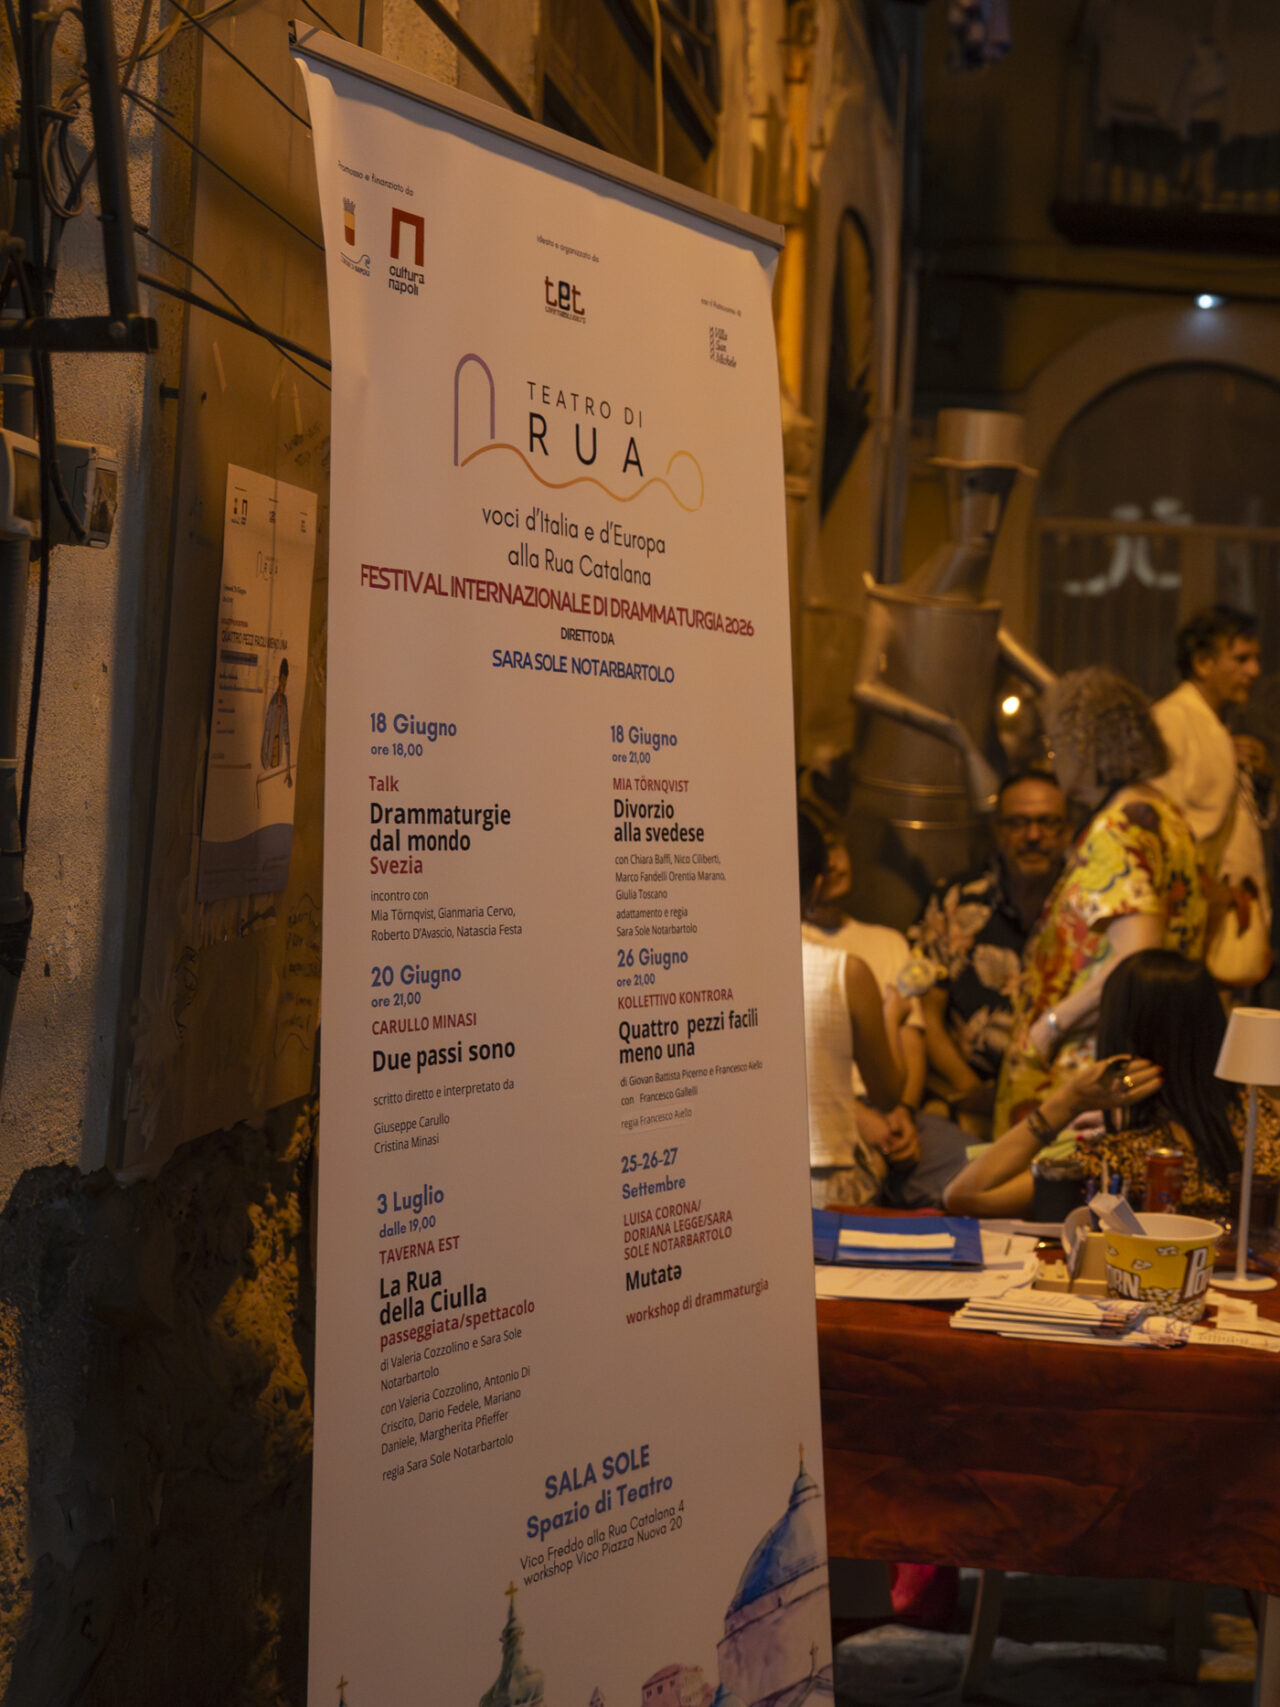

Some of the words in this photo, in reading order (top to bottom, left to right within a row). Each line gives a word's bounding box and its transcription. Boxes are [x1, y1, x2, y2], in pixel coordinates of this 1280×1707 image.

[388, 278, 418, 297] napoli
[389, 264, 425, 285] cultura
[544, 275, 586, 316] tet
[526, 380, 612, 420] TEATRO
[624, 406, 643, 428] DI
[529, 412, 644, 477] RUA
[482, 506, 519, 529] voci
[526, 505, 578, 539] d'Italia
[584, 524, 594, 542] e
[600, 520, 666, 559] d'Europa
[508, 542, 540, 569] alla
[545, 548, 574, 575] Rua
[580, 554, 652, 586] Catalana
[360, 563, 448, 597] FESTIVAL
[450, 575, 591, 616] INTERNAZIONALE
[594, 594, 608, 617] DI
[610, 597, 724, 632] DRAMMATURGIA
[726, 614, 755, 637] 2026
[560, 626, 600, 644] DIRETTO
[601, 630, 615, 646] DA
[492, 648, 533, 670] SARA
[534, 652, 568, 674] SOLE
[570, 656, 676, 684] NOTARBARTOLO
[370, 712, 387, 733] 18
[393, 713, 457, 742] Giugno
[610, 724, 624, 744] 18
[628, 725, 678, 751] Giugno
[370, 745, 390, 756] ore
[392, 743, 424, 758] 18,00
[612, 752, 627, 763] ore
[368, 775, 400, 792] Talk
[612, 777, 632, 791] MIA
[634, 775, 690, 794] TÖRNQVIST
[370, 802, 512, 832] Drammaturgie
[613, 799, 675, 820] Divorzio
[370, 828, 400, 851] dal
[408, 828, 471, 851] mondo
[614, 822, 642, 842] alla
[646, 822, 705, 842] svedese
[370, 855, 423, 875] Svezia
[616, 872, 639, 882] Marco
[370, 890, 410, 902] incontro
[412, 890, 429, 901] con
[638, 888, 668, 900] Toscano
[371, 910, 388, 922] Mia
[438, 906, 484, 919] Gianmaria
[616, 909, 662, 920] adattamento
[670, 906, 688, 920] regia
[371, 929, 410, 942] Roberto
[456, 924, 496, 938] Natascia
[499, 923, 522, 936] Festa
[616, 926, 633, 937] Sara
[635, 925, 650, 936] Sole
[652, 923, 698, 936] Notarbartolo
[617, 948, 634, 968] 26
[639, 948, 688, 970] Giugno
[371, 965, 394, 987] 20
[400, 964, 462, 990] Giugno
[616, 977, 632, 987] ore
[371, 996, 390, 1008] ore
[393, 992, 422, 1008] 21,00
[618, 992, 677, 1010] KOLLETTIVO
[679, 988, 734, 1004] KONTRORA
[372, 1016, 429, 1035] CARULLO
[432, 1012, 477, 1030] MINASI
[619, 1019, 679, 1044] Quattro
[687, 1012, 725, 1039] pezzi
[729, 1008, 758, 1029] facili
[372, 1050, 411, 1072] Due
[417, 1041, 462, 1074] passi
[469, 1041, 515, 1061] sono
[619, 1043, 663, 1064] meno
[667, 1040, 695, 1058] una
[373, 1092, 403, 1106] scritto
[405, 1089, 434, 1102] diretto
[436, 1088, 442, 1098] e
[444, 1080, 500, 1097] interpretato
[503, 1078, 514, 1090] da
[639, 1090, 674, 1103] Francesco
[374, 1119, 417, 1135] Giuseppe
[419, 1113, 450, 1128] Carullo
[640, 1112, 672, 1126] Francesco
[374, 1139, 409, 1154] Cristina
[411, 1133, 439, 1148] Minasi
[620, 1147, 679, 1174] 25-26-27
[377, 1193, 388, 1214] 3
[394, 1184, 445, 1214] Luglio
[622, 1174, 686, 1199] Settembre
[623, 1209, 653, 1227] LUISA
[655, 1200, 702, 1221] CORONA/
[379, 1221, 406, 1239] dalle
[409, 1215, 436, 1233] 19,00
[624, 1224, 671, 1244] DORIANA
[673, 1210, 733, 1233] LEGGE/SARA
[379, 1240, 436, 1265] TAVERNA
[438, 1235, 460, 1252] EST
[624, 1244, 649, 1261] SOLE
[652, 1226, 732, 1255] NOTARBARTOLO
[380, 1277, 400, 1299] La
[407, 1270, 442, 1293] Rua
[380, 1296, 424, 1325] della
[431, 1283, 487, 1313] Ciulla
[626, 1300, 680, 1324] workshop
[683, 1296, 692, 1310] di
[695, 1278, 769, 1308] drammaturgia
[380, 1299, 535, 1352] passeggiata/spettacolo
[390, 1351, 422, 1369] Valeria
[424, 1340, 470, 1360] Cozzolino
[481, 1333, 501, 1347] Sara
[503, 1327, 522, 1341] Sole
[380, 1366, 440, 1392] Notarbartolo
[380, 1402, 397, 1415] con
[399, 1392, 431, 1409] Valeria
[432, 1380, 481, 1400] Cozzolino,
[483, 1370, 520, 1388] Antonio
[522, 1365, 531, 1378] Di
[381, 1417, 416, 1435] Criscito,
[418, 1409, 445, 1424] Dario
[447, 1399, 481, 1416] Fedele,
[484, 1388, 521, 1407] Mariano
[381, 1436, 417, 1455] Daniele,
[419, 1420, 473, 1443] Margherita
[382, 1465, 405, 1481] regia
[406, 1457, 428, 1473] Sara
[430, 1450, 451, 1466] Sole
[453, 1433, 514, 1459] Notarbartolo
[545, 1462, 597, 1500] SALA
[602, 1444, 650, 1480] SOLE
[527, 1501, 590, 1542] Spazio
[595, 1489, 611, 1515] di
[616, 1476, 673, 1507] Teatro
[520, 1554, 545, 1570] Vico
[547, 1536, 584, 1562] Freddo
[587, 1527, 605, 1547] alla
[609, 1524, 628, 1538] Rua
[630, 1506, 676, 1531] Catalana
[678, 1499, 685, 1512] 4
[523, 1559, 573, 1586] workshop
[575, 1549, 599, 1566] Vico
[602, 1536, 634, 1557] Piazza
[637, 1524, 667, 1544] Nuova
[670, 1515, 683, 1533] 20
